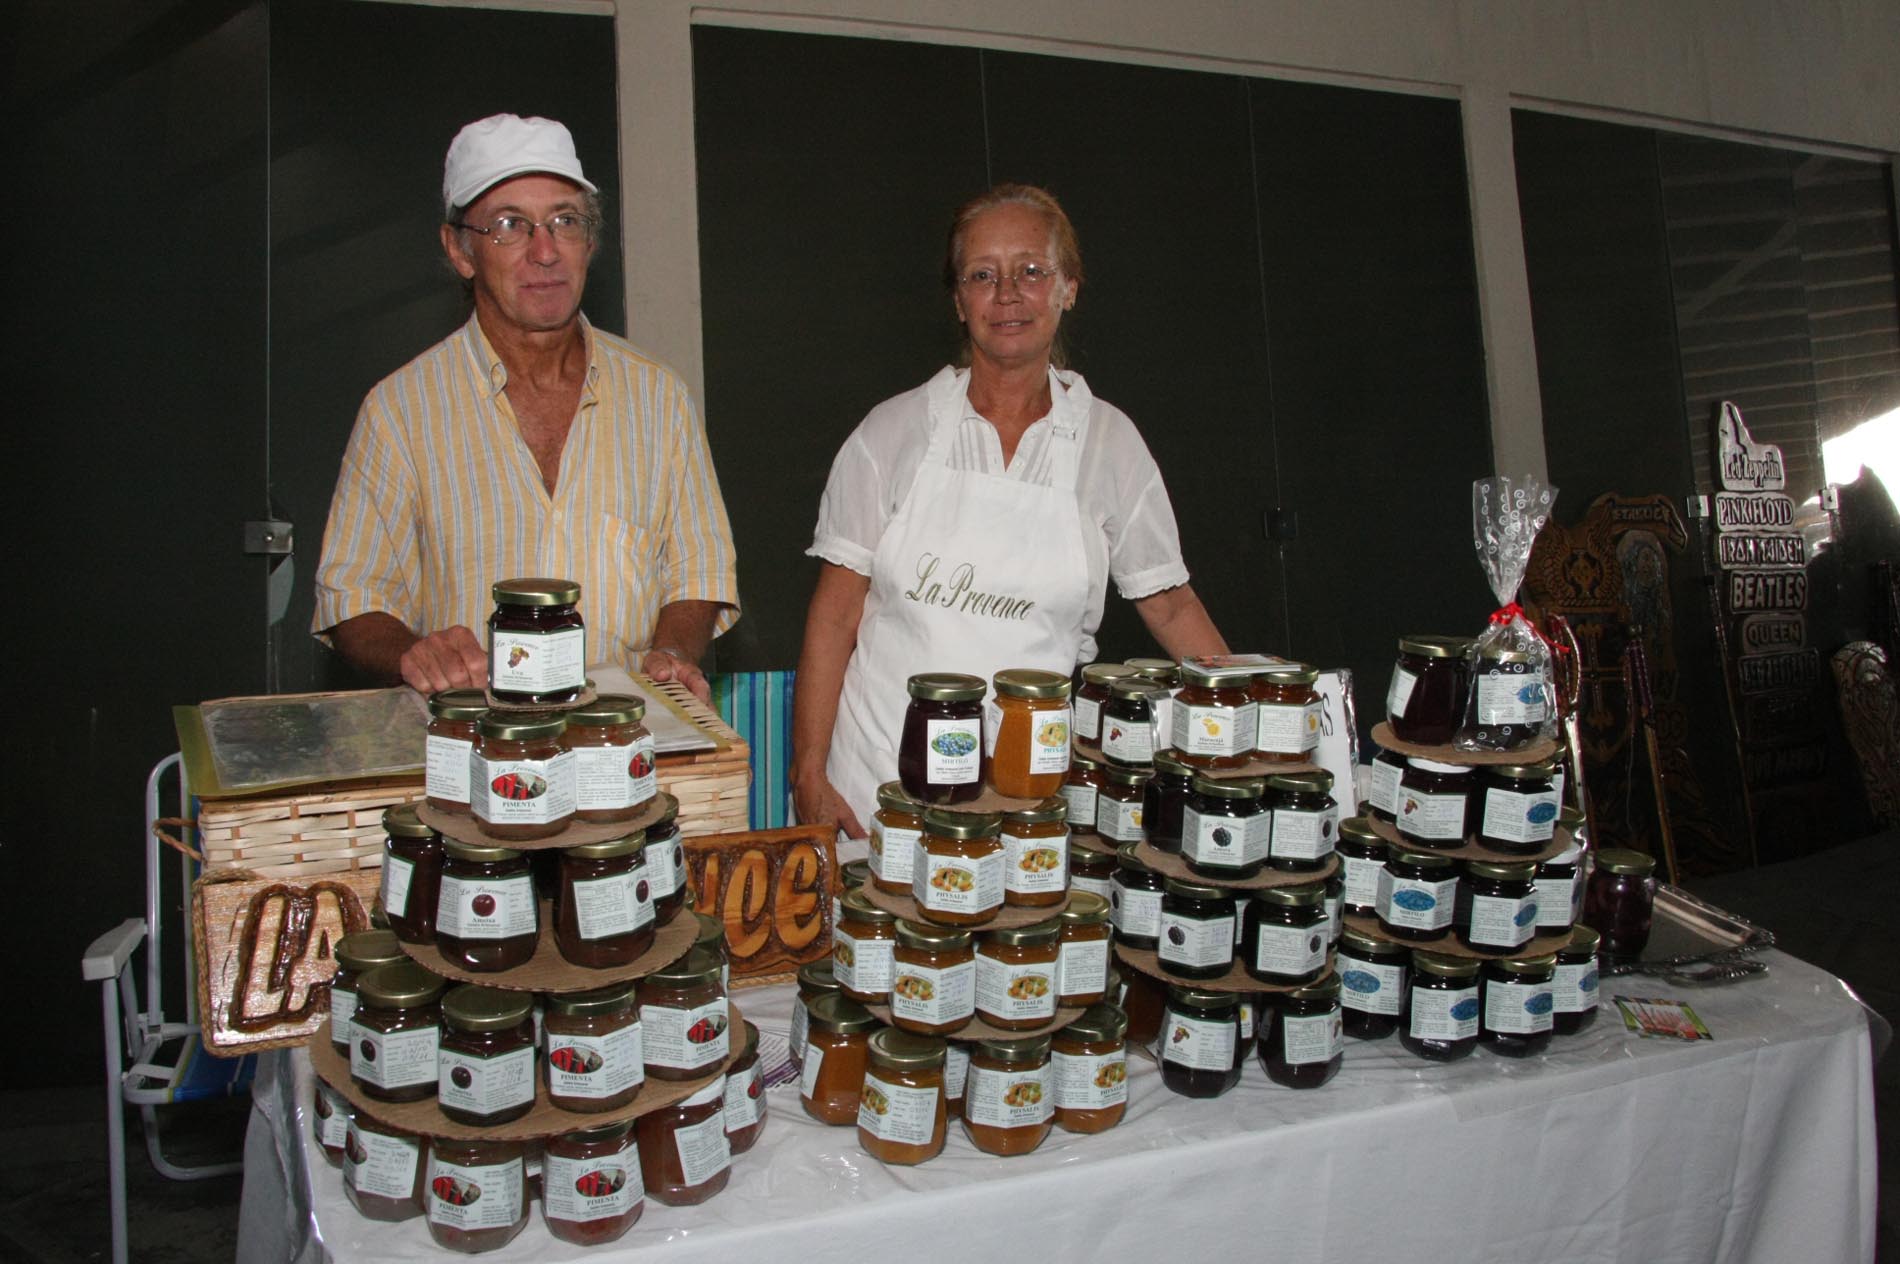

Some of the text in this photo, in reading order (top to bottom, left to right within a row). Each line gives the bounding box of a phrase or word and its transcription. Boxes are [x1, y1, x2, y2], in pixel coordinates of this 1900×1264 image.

[1722, 451, 1782, 488] Led Zeppelin
[1717, 496, 1795, 526] PINK FLOYD
[1720, 535, 1758, 565] IRON
[904, 552, 1016, 621] La Provence
[1731, 572, 1806, 611] BEATLES
[1746, 621, 1802, 646] QUEEN
[560, 1073, 593, 1082] PIMENTA
